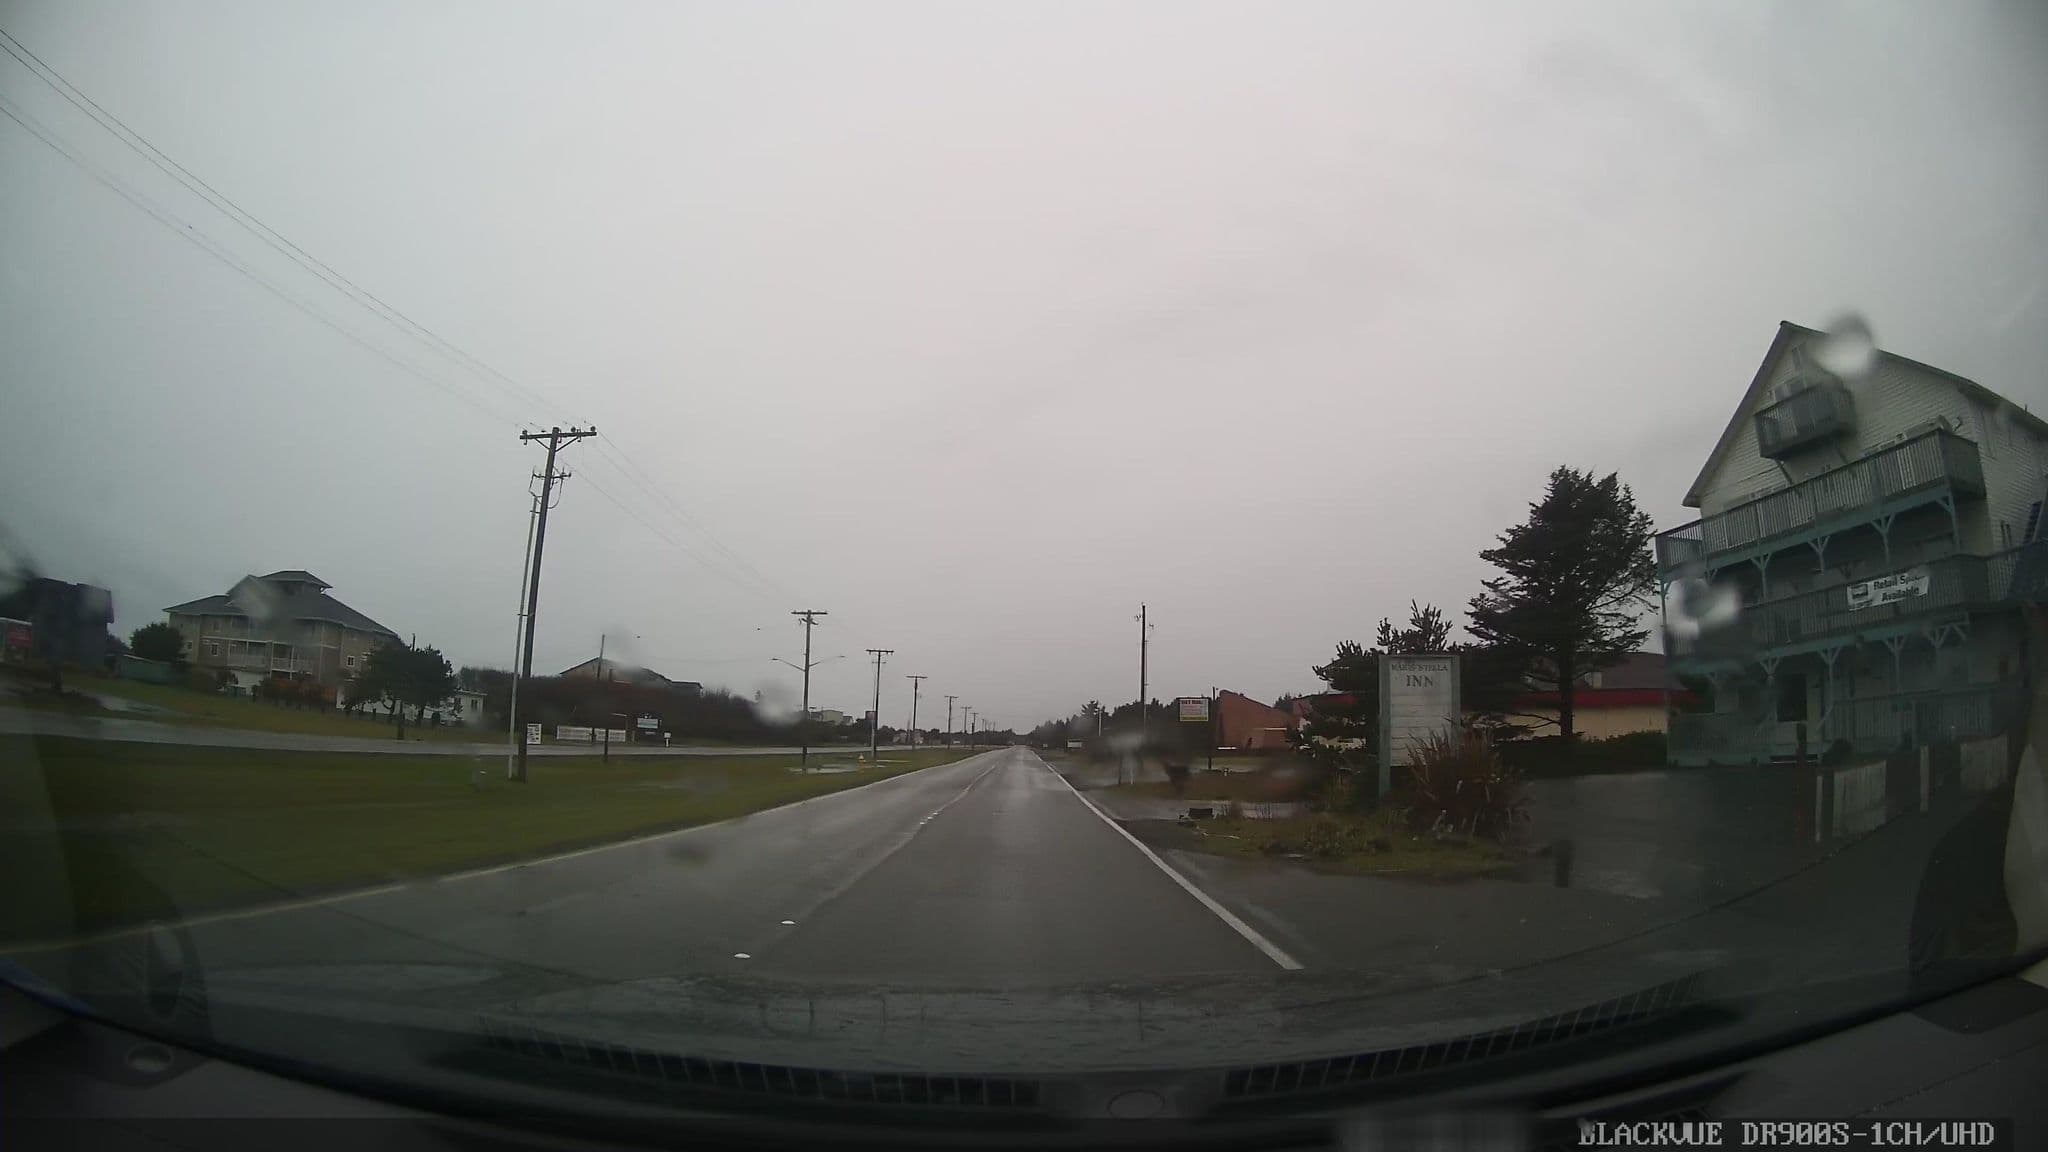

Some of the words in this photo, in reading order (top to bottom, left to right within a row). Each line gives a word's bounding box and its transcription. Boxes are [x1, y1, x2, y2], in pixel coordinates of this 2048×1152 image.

[1873, 577, 1898, 590] Retail
[1882, 586, 1919, 601] Available
[1406, 674, 1433, 687] INN
